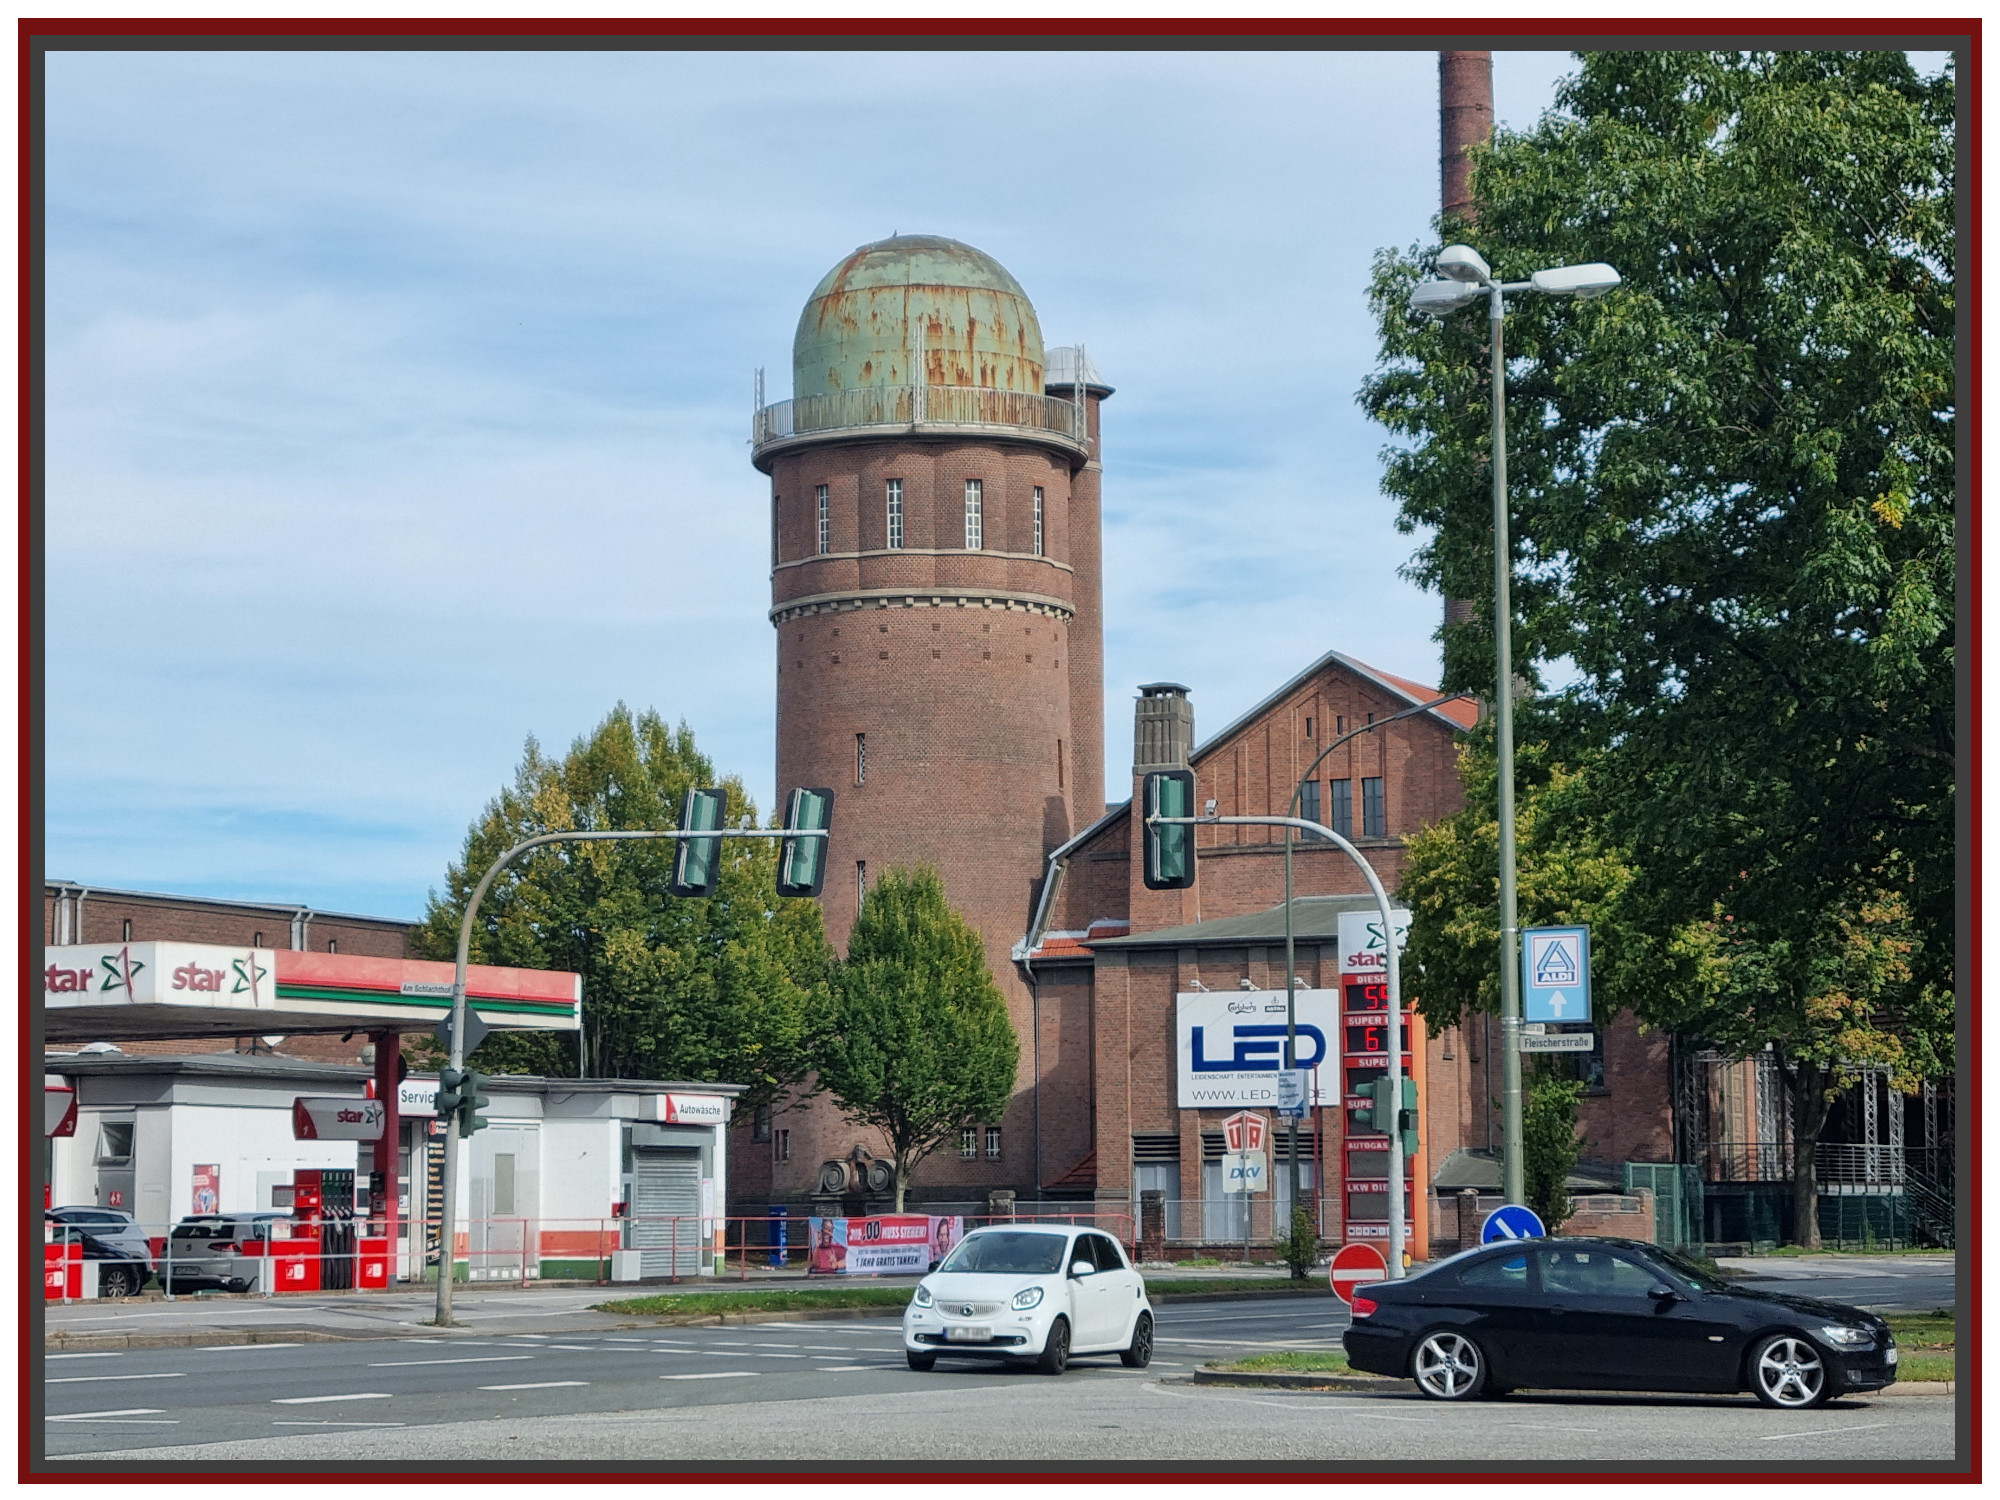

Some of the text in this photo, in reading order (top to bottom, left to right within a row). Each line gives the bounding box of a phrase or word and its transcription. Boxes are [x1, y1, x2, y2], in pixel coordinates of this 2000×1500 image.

[172, 961, 226, 992] star
[1357, 975, 1388, 984] DIESE
[1541, 972, 1572, 981] ALDI
[1348, 1016, 1382, 1026] SUPER
[1524, 1038, 1588, 1047] Fleischerstraße
[1192, 1023, 1326, 1073] LED
[1358, 1058, 1388, 1067] SUPE
[1237, 1072, 1278, 1080] ENTERTAINMEN
[401, 1089, 434, 1104] Servic
[680, 1104, 720, 1115] Autowäsche
[337, 1108, 363, 1123] star
[66, 1120, 73, 1132] 3
[1348, 1142, 1388, 1150] AUTOGAS
[1229, 1166, 1261, 1179] DKV
[1347, 1184, 1410, 1193] LKW DIEL
